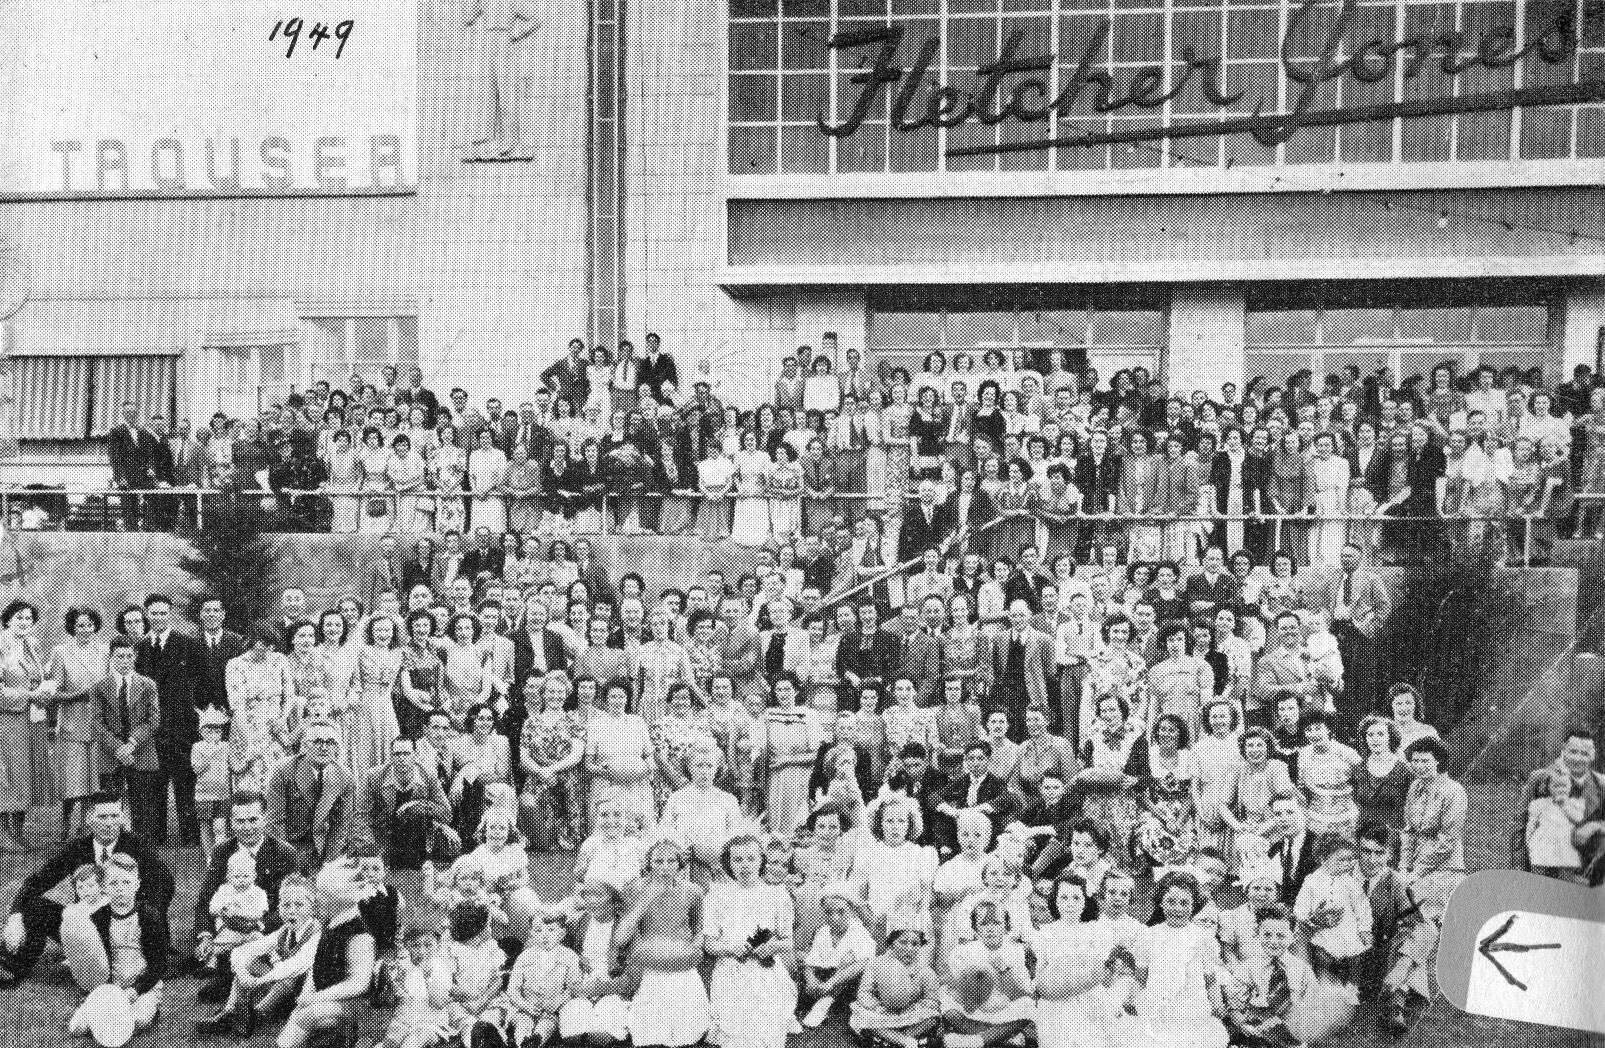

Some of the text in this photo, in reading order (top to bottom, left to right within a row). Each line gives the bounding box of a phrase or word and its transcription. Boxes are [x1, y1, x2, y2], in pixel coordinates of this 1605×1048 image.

[269, 17, 354, 59] 1949
[818, 0, 1578, 147] Fletcher Jones
[51, 135, 402, 192] TROUSER
